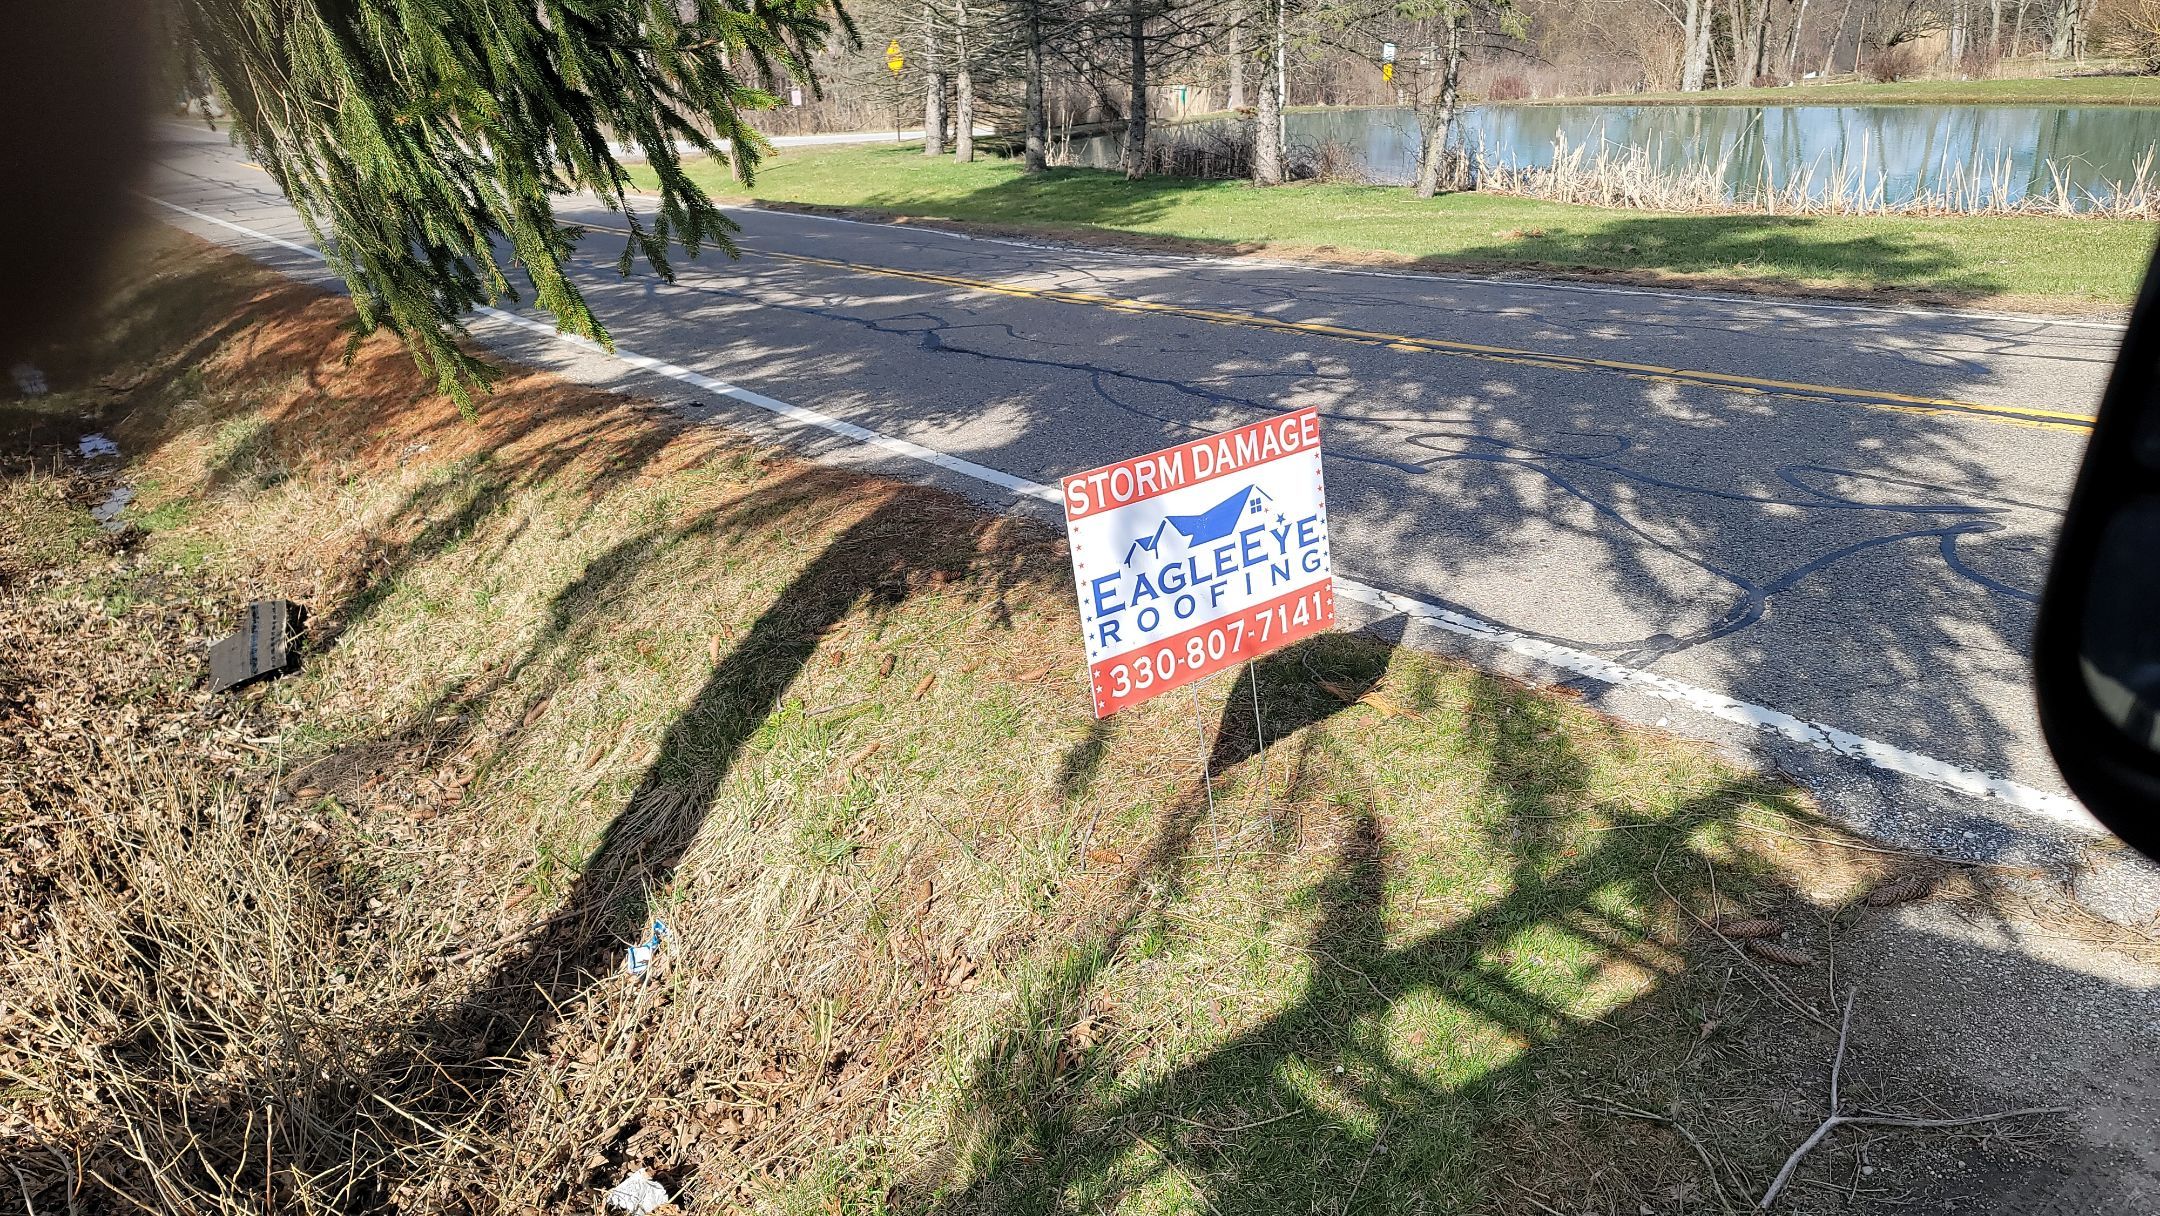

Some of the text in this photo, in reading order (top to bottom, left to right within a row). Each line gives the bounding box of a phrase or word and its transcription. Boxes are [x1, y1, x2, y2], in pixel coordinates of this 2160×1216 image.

[1067, 412, 1320, 515] STORM DAMAGE
[1098, 549, 1321, 648] ROOFING
[1109, 590, 1323, 699] 330-807-7141
